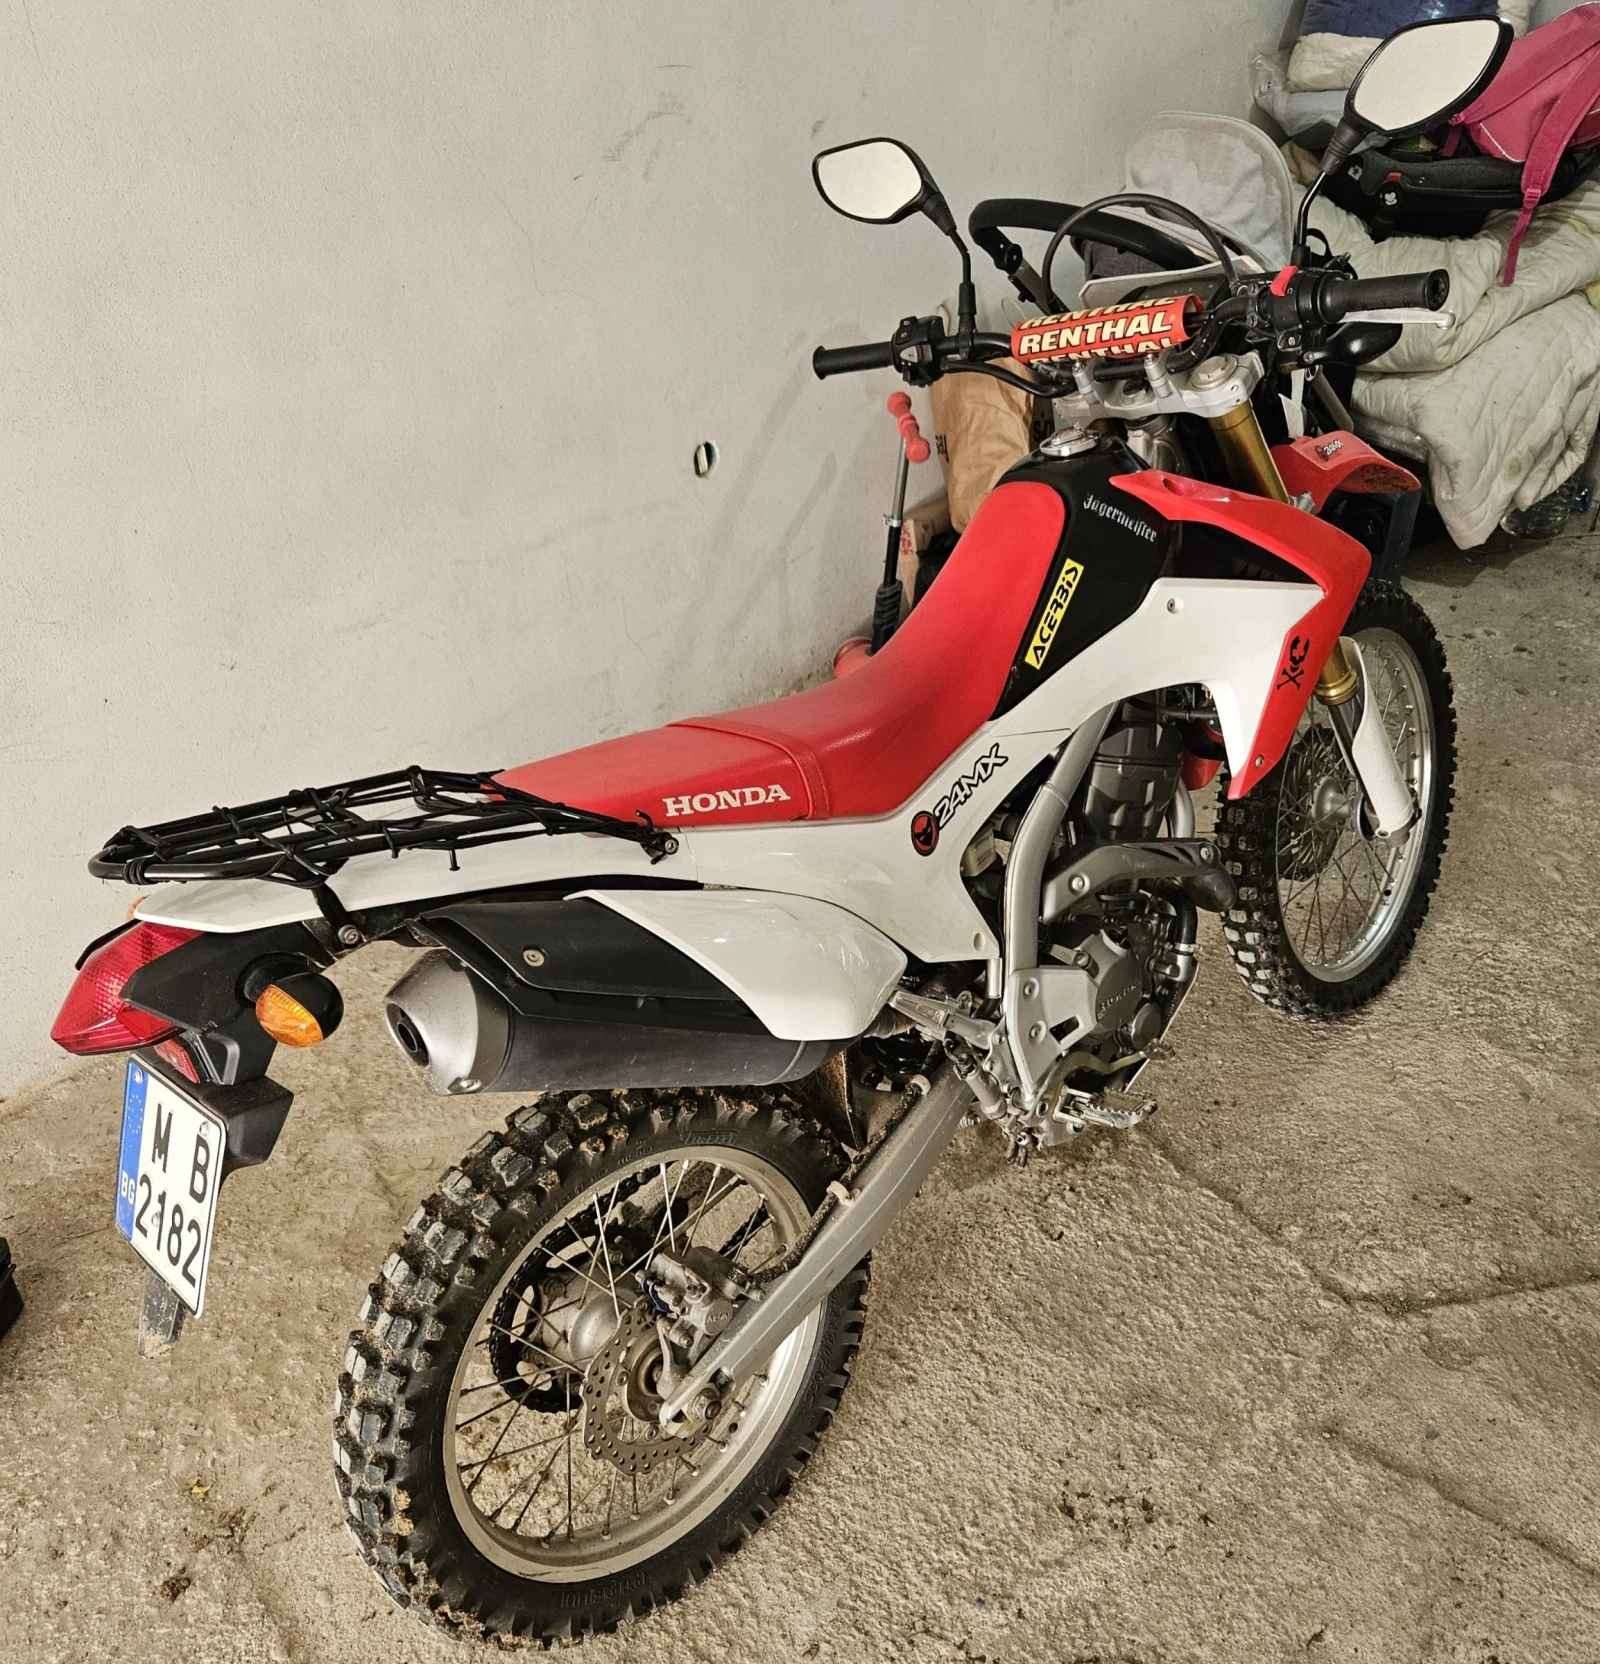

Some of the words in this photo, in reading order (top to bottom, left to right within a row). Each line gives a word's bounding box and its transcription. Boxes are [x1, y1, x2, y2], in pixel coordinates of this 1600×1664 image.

[1019, 311, 1173, 356] RENTHAL
[662, 783, 791, 817] HONDA
[933, 742, 1009, 831] 24MX
[121, 1170, 136, 1206] BG
[135, 1173, 202, 1288] 2182
